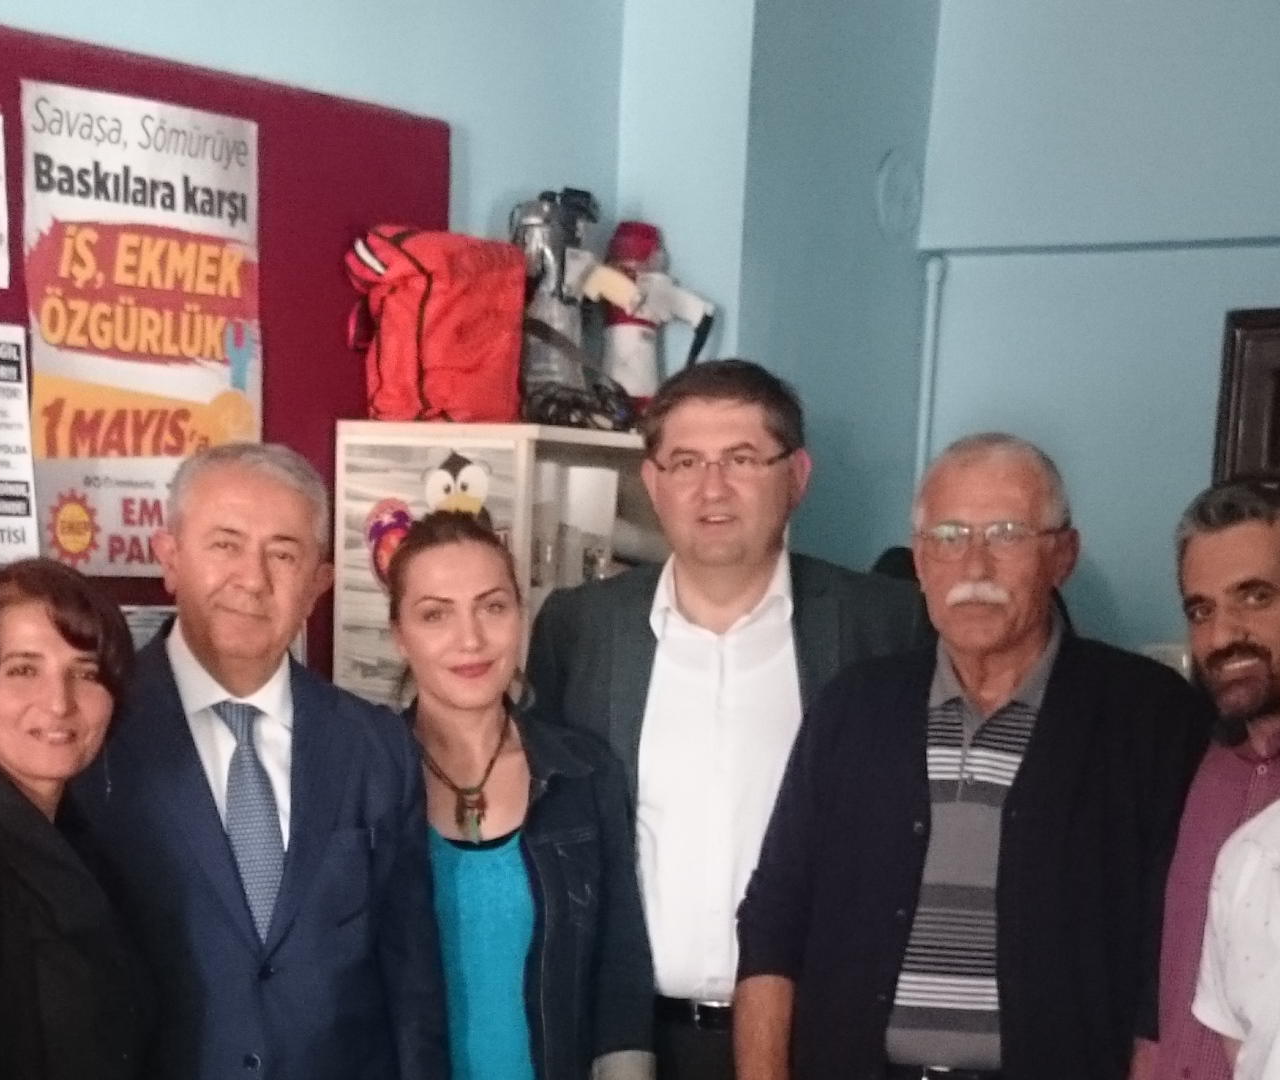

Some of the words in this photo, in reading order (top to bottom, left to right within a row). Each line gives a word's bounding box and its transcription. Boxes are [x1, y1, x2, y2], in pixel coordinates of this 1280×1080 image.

[32, 96, 128, 149] Savaşa,
[138, 113, 248, 170] Sömürüye
[33, 152, 175, 211] Baskılara
[183, 175, 248, 227] karşı
[59, 224, 105, 289] İŞ,
[114, 232, 244, 298] EKMEK
[39, 287, 226, 361] ÖZGÜRLÜK
[42, 397, 66, 458] 1
[122, 497, 163, 527] EM
